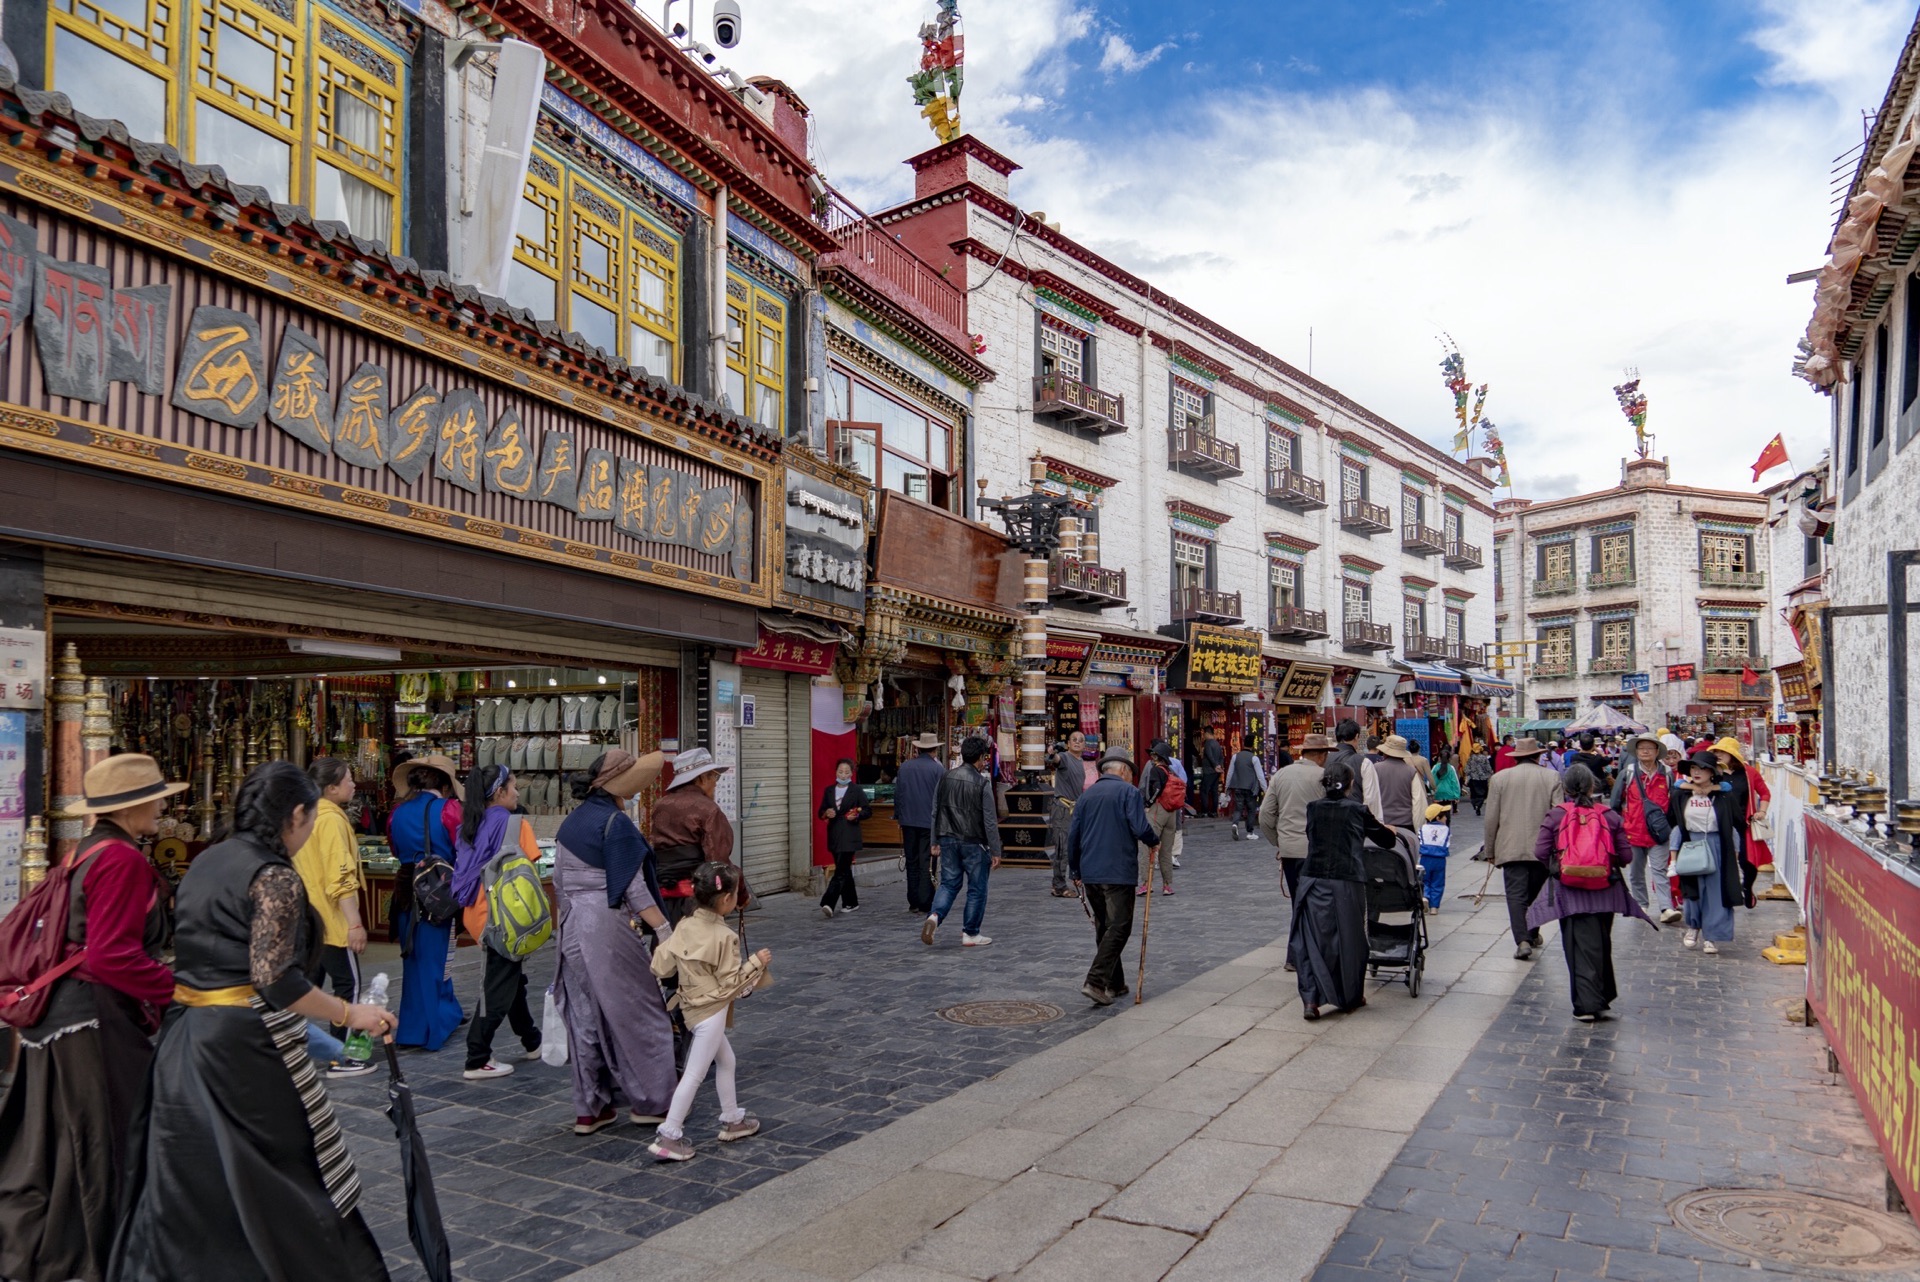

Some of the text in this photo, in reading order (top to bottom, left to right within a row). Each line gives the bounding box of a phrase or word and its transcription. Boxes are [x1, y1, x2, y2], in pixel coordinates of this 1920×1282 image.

[1192, 648, 1259, 677] 古城老珠宝店
